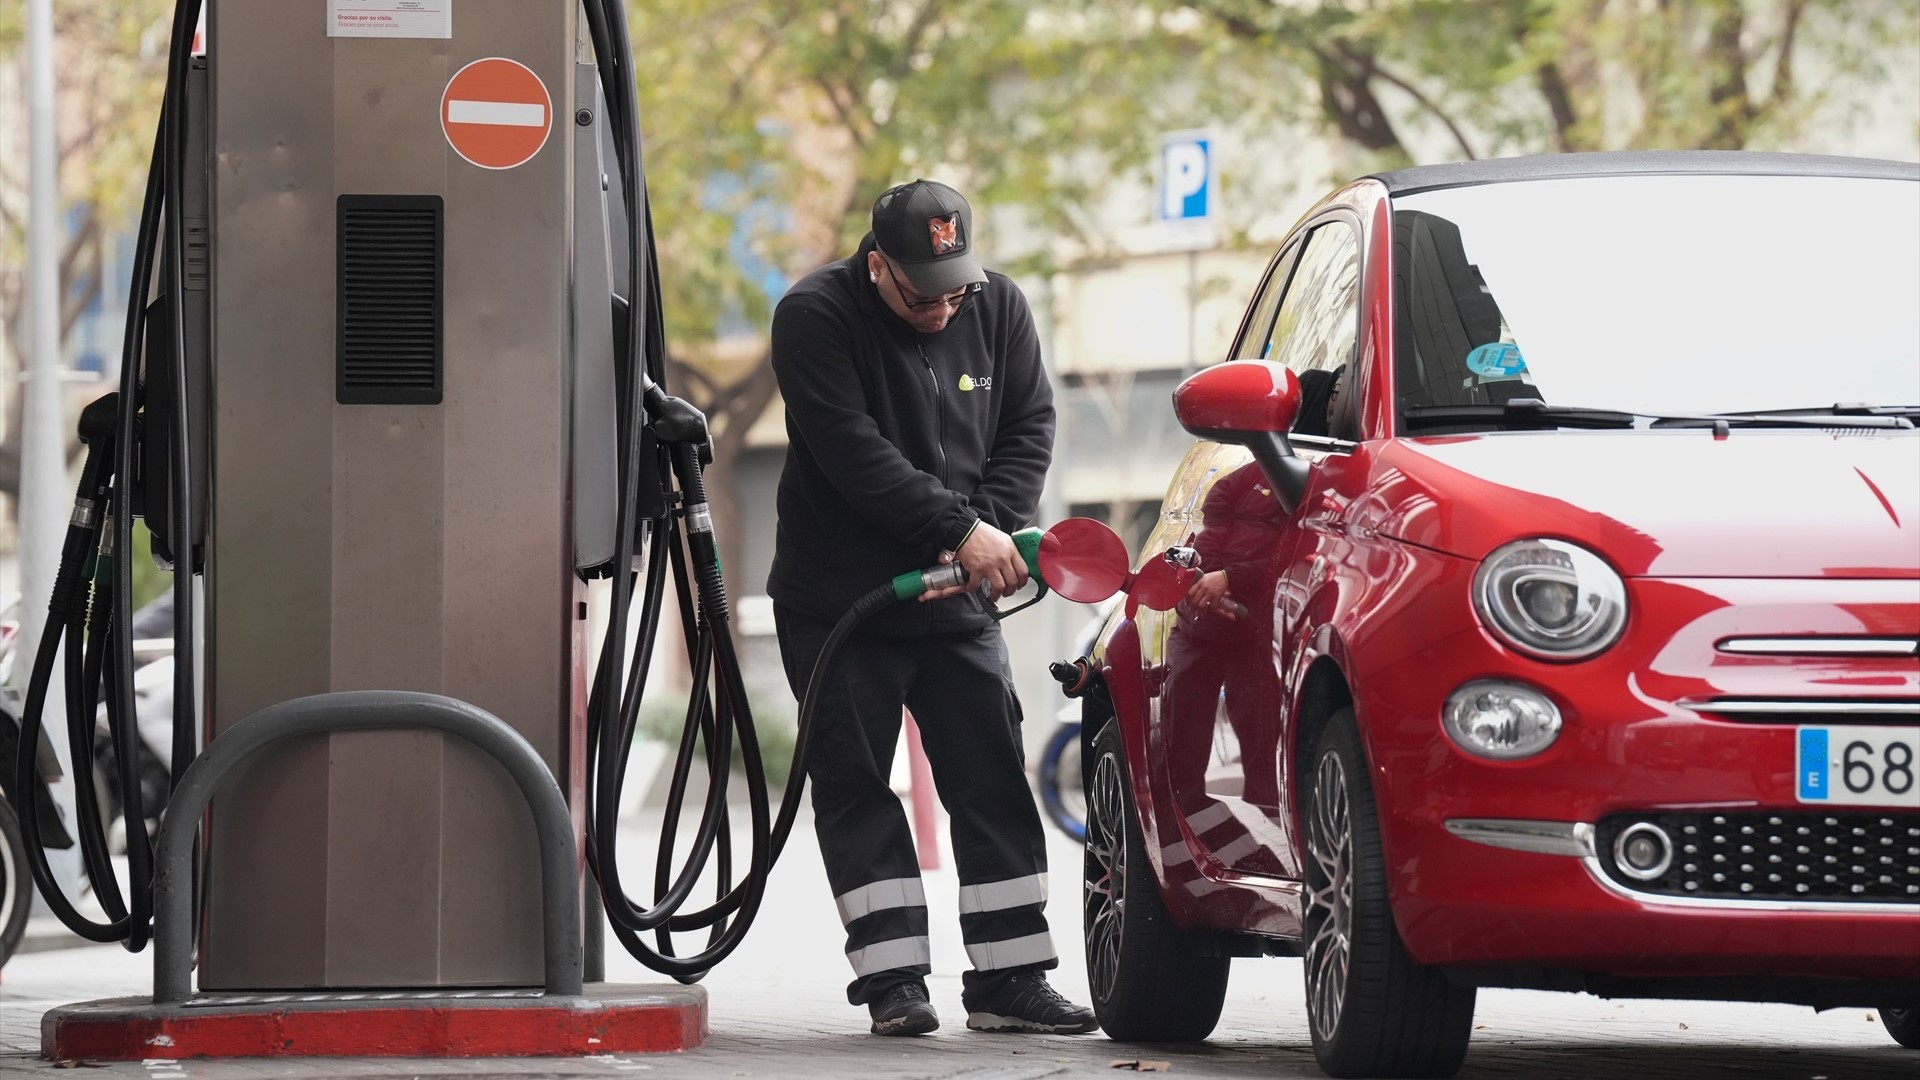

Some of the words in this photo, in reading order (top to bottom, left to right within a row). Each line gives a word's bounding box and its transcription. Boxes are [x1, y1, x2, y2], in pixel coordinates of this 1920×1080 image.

[1166, 144, 1206, 217] P
[1808, 771, 1820, 787] E
[1843, 740, 1914, 795] 68
